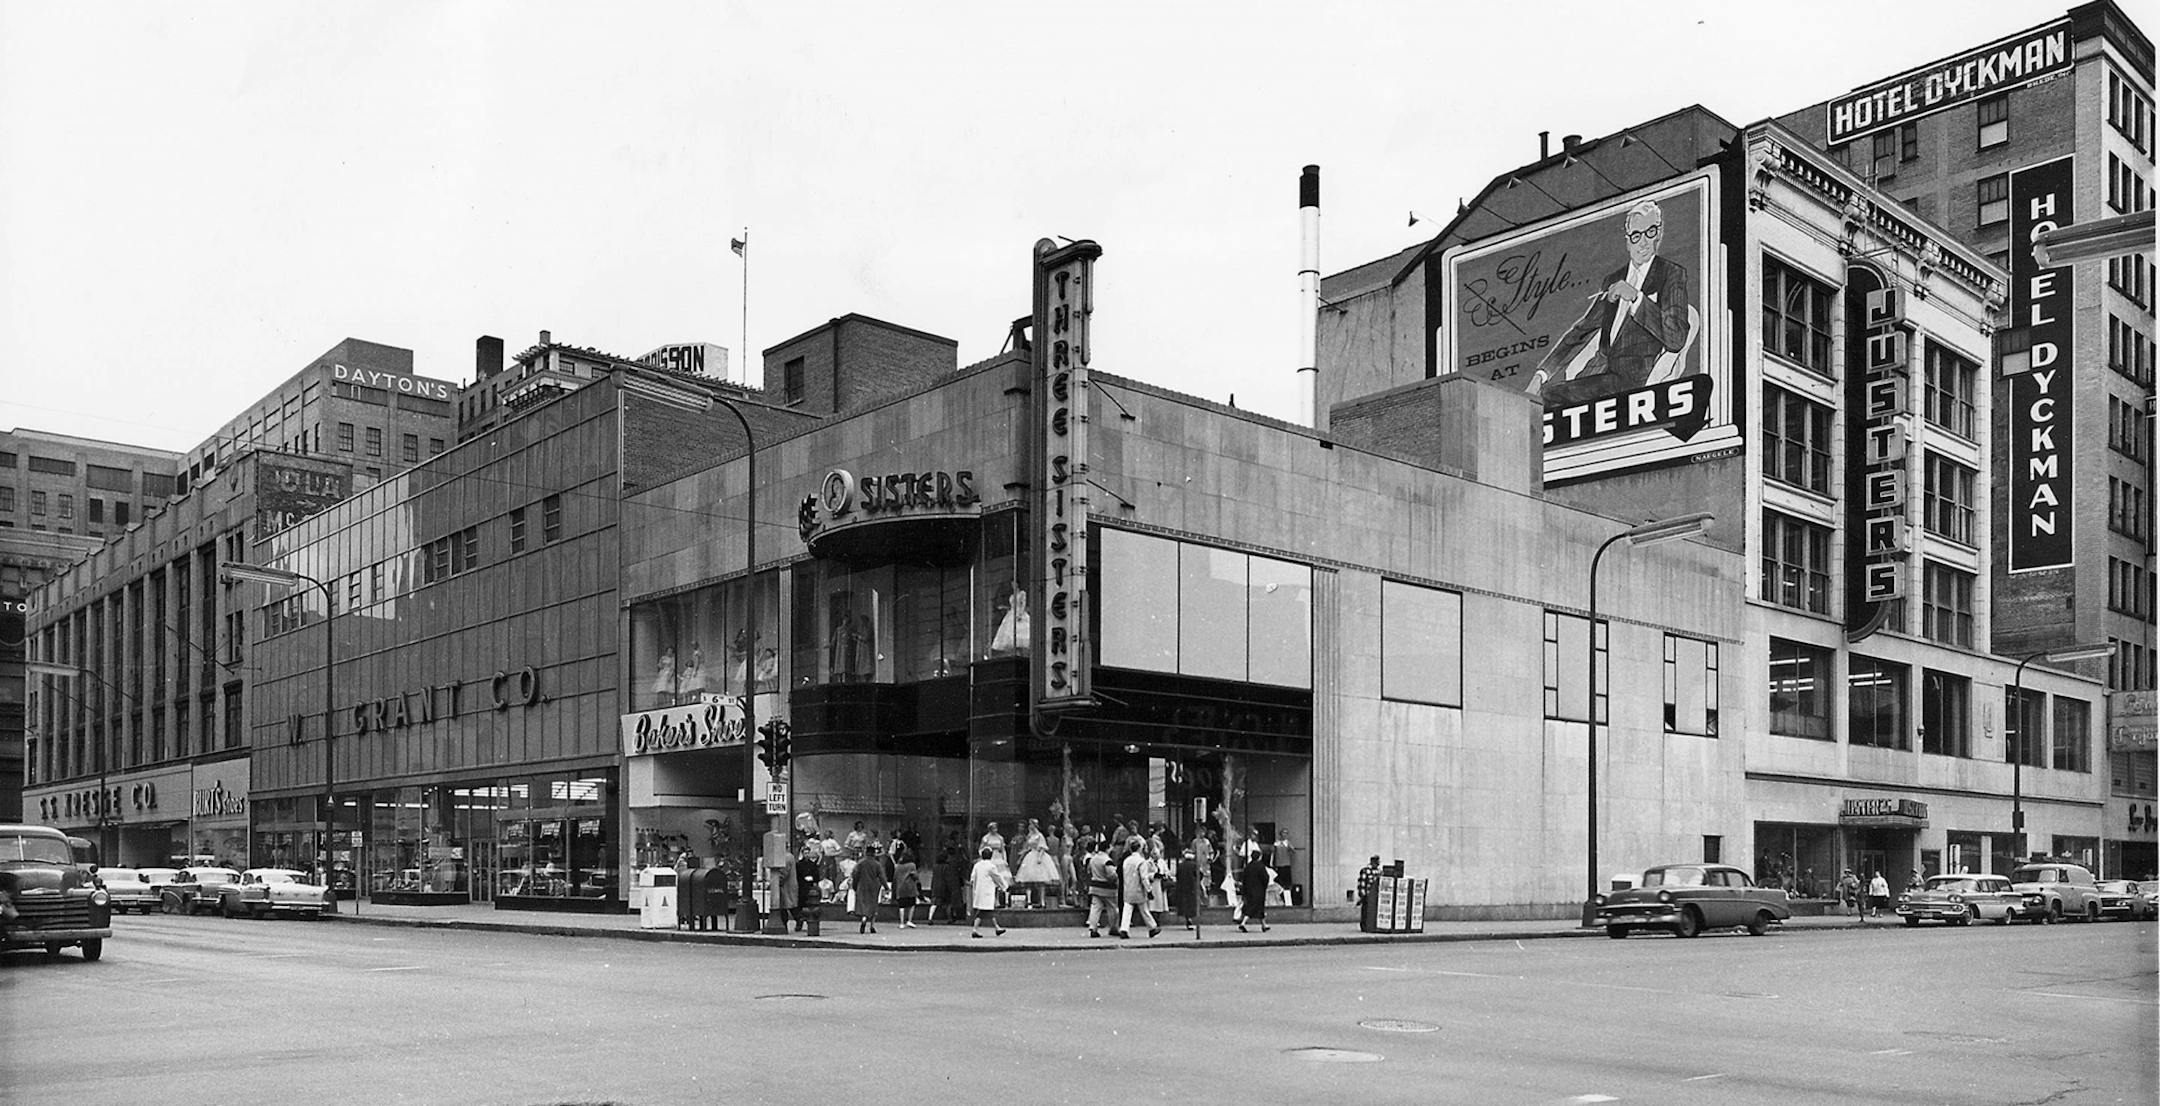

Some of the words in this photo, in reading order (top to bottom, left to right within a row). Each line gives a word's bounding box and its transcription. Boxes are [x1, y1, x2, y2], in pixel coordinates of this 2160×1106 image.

[1835, 83, 1918, 136] HOTEL
[1925, 30, 2065, 107] DYCKMAN
[2030, 193, 2057, 327] HOEL
[335, 364, 448, 398] DAYTON'S
[1052, 271, 1070, 437] THREE
[1465, 335, 1550, 368] BEGINS
[1491, 363, 1520, 381] AT
[1870, 290, 1898, 598] JUSTERS
[2029, 341, 2059, 538] DYCKMAN
[861, 471, 982, 513] SISTERS
[1050, 455, 1069, 689] SISTERS
[354, 680, 461, 735] GRANT
[491, 665, 551, 712] CO.
[633, 714, 696, 753] Baker's
[700, 705, 747, 746] Shoe
[769, 803, 786, 811] TURN
[773, 784, 783, 793] NO
